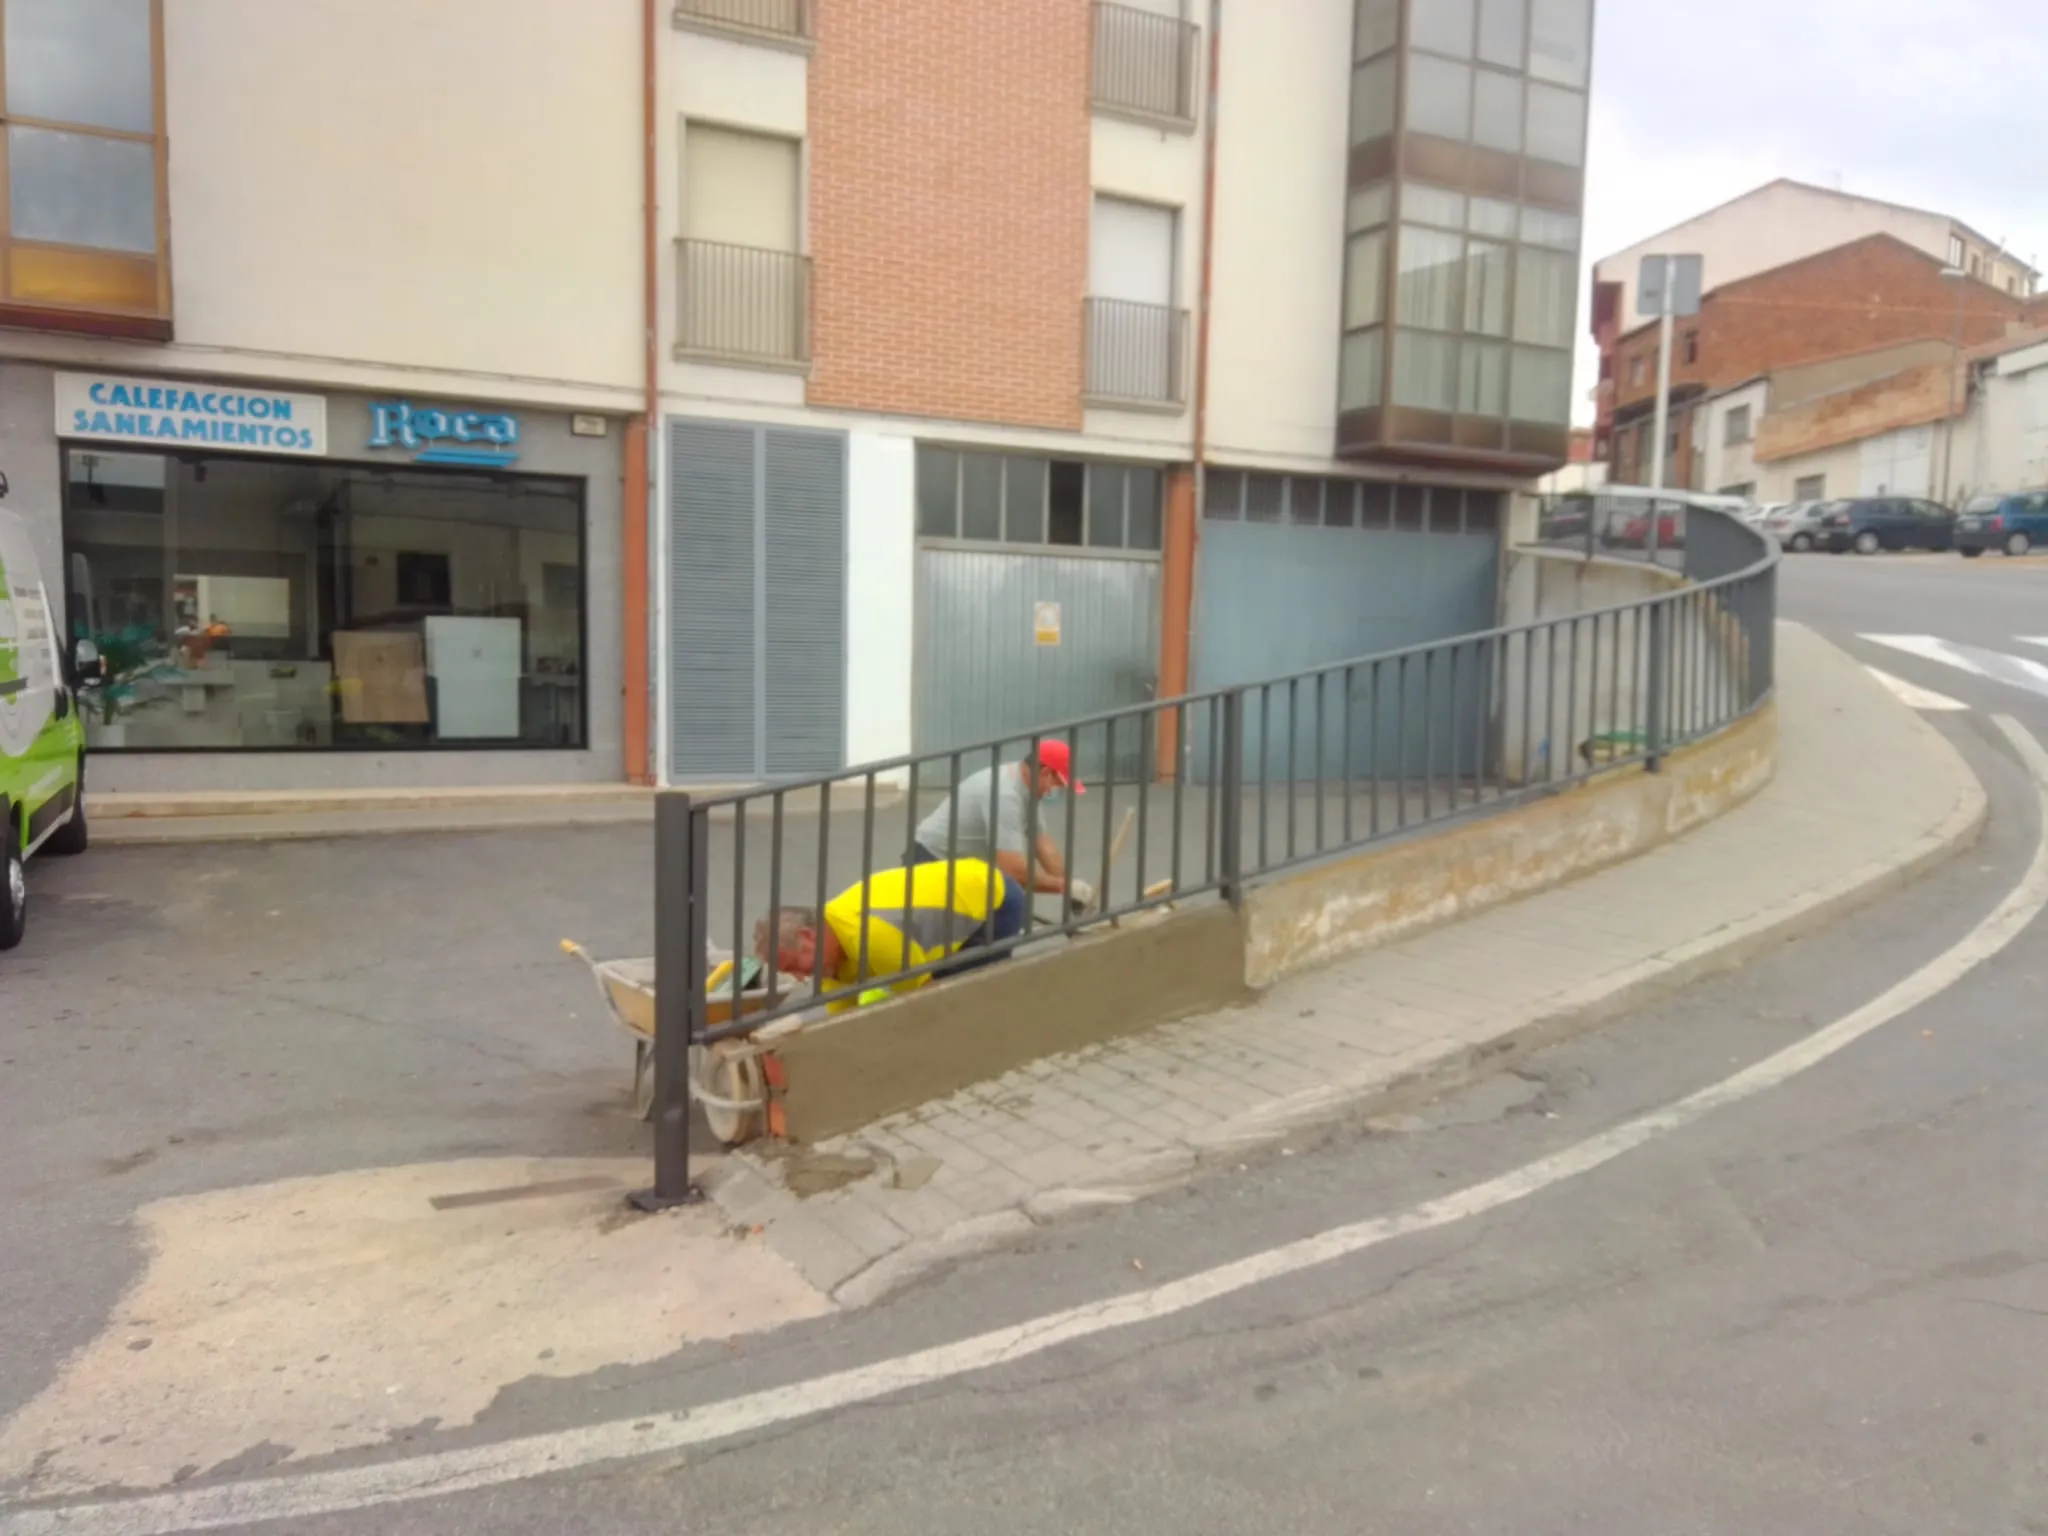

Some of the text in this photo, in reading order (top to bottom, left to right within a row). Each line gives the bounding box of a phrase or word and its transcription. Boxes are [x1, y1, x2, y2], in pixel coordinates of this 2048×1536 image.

[89, 382, 292, 420] CALEFACCION
[73, 409, 313, 449] SANEAMIENTOS
[368, 400, 519, 448] Roca
